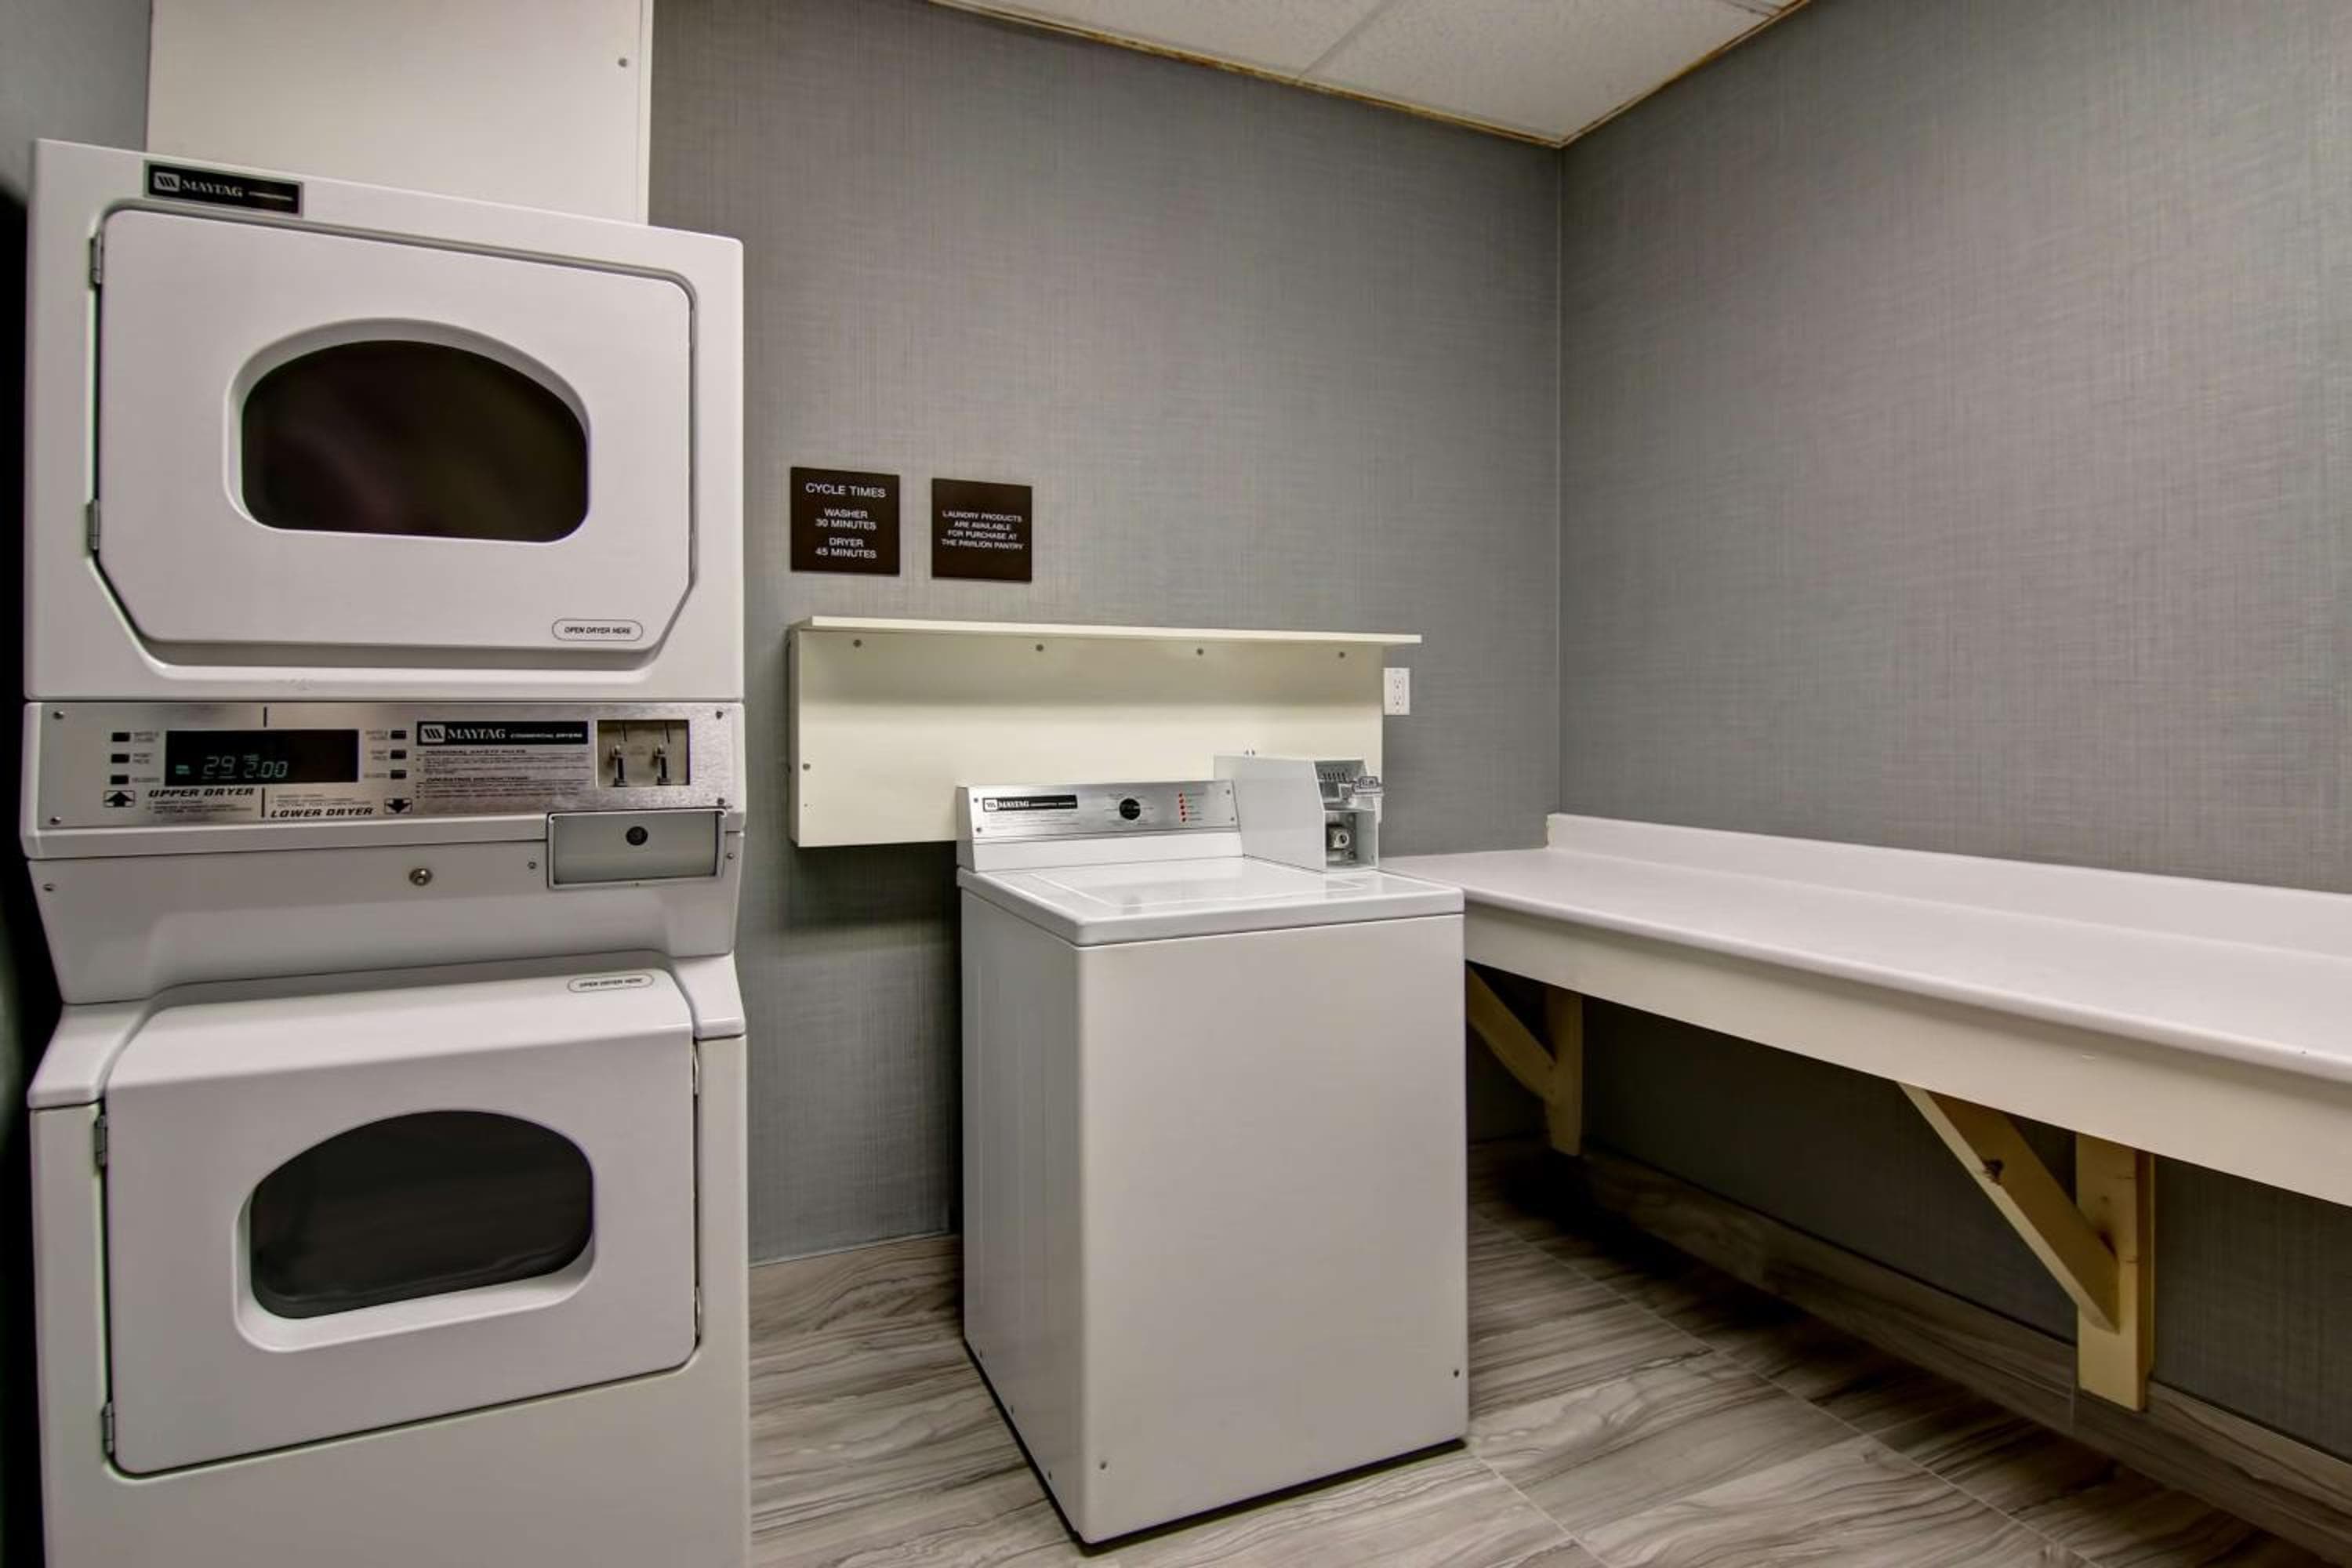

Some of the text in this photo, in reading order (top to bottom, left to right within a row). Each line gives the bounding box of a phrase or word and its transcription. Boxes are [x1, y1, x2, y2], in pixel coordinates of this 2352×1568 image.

[181, 180, 243, 198] MAYTAG
[805, 482, 887, 498] CYCLE TIMES
[824, 508, 868, 519] WASHER
[942, 510, 1022, 523] LAUNDRY PRODUCTS
[815, 518, 877, 531] 30 MINUTES
[972, 521, 1011, 531] AVAILABLE
[965, 531, 1007, 540] PURCHASE
[829, 537, 864, 547] DRYER
[942, 538, 956, 546] THE
[959, 539, 993, 548] PAVILION
[815, 547, 877, 559] 45 MINUTES
[447, 728, 506, 739] MAYTAG
[148, 787, 254, 797] UPPER DRYER
[270, 806, 374, 818] LOWER DRYER
